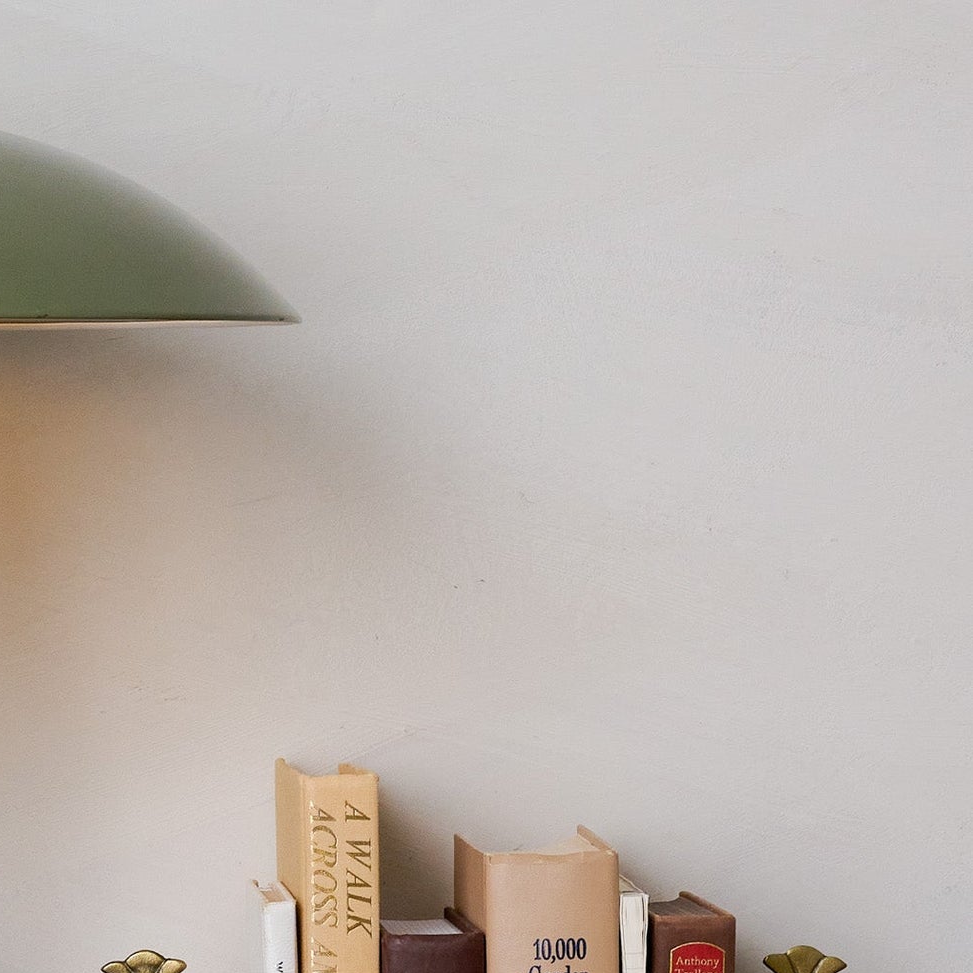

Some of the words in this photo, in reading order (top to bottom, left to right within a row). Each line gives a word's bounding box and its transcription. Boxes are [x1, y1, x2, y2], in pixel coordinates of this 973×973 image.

[344, 800, 371, 822] A
[308, 799, 339, 929] ACROSS
[345, 837, 373, 939] WALK
[533, 938, 587, 963] 10,000
[675, 956, 719, 969] Anthony
